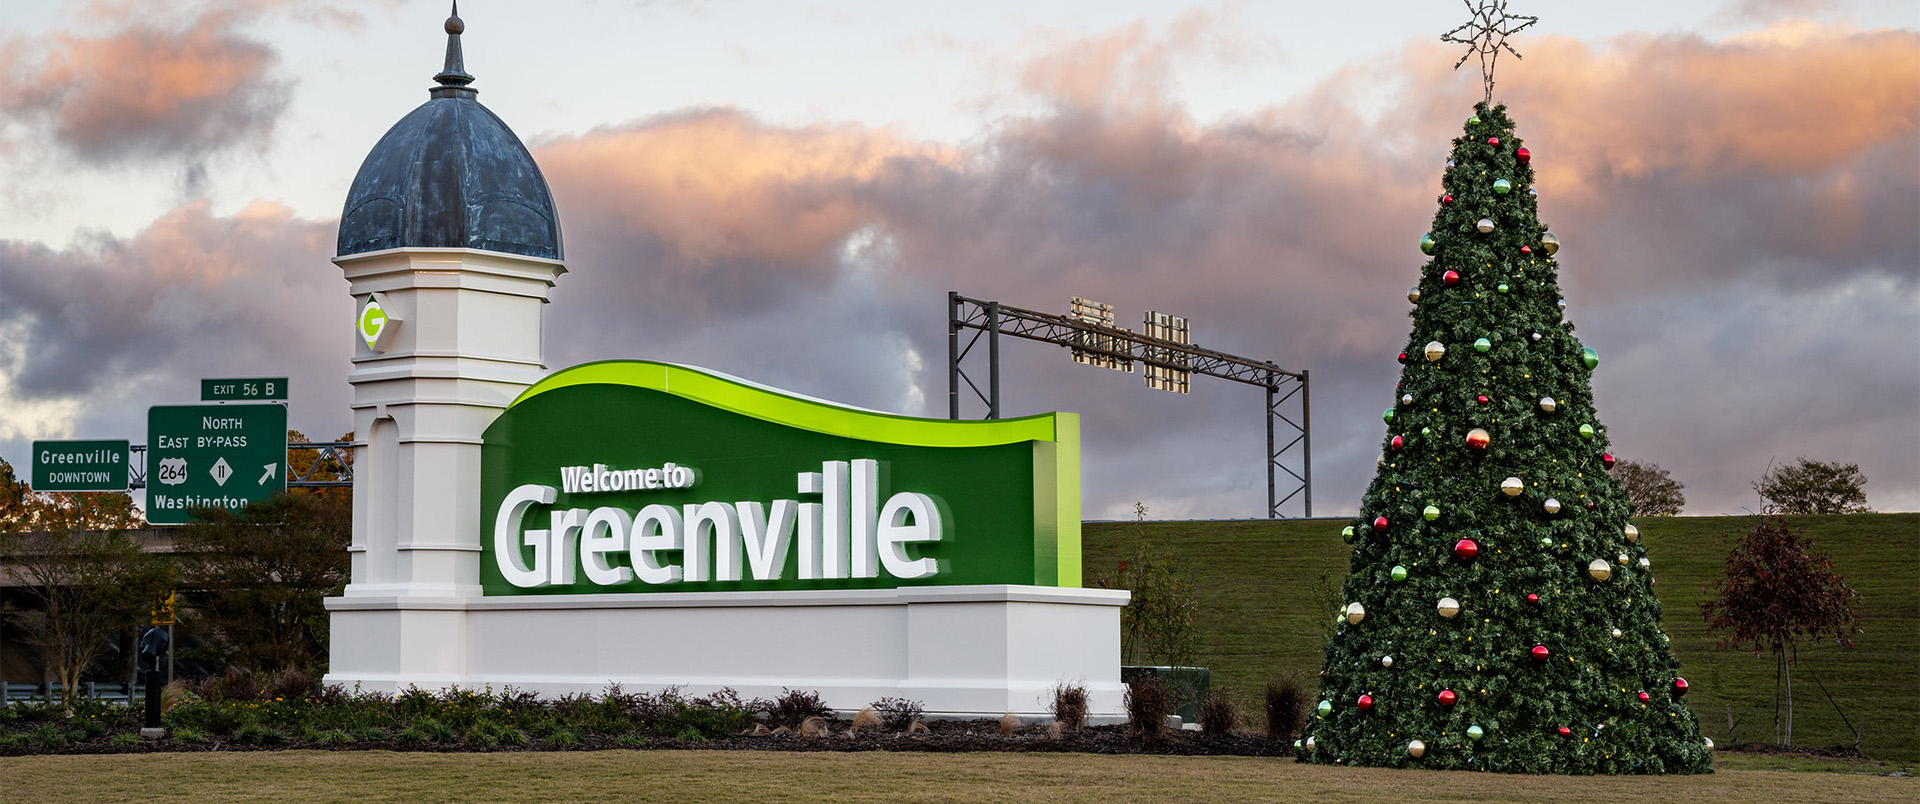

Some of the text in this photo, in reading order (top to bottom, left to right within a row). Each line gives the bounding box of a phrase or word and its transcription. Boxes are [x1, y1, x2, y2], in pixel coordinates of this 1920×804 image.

[360, 301, 385, 343] G
[213, 382, 275, 396] EXIT 56 B
[202, 416, 243, 430] NORTH
[158, 435, 247, 448] EAST BY-PASS
[41, 450, 120, 464] Greenville
[49, 472, 110, 483] DOWNTOWN
[160, 464, 186, 480] 264
[217, 465, 225, 479] 11
[560, 462, 695, 493] Welcome to
[494, 458, 943, 588] Greenville
